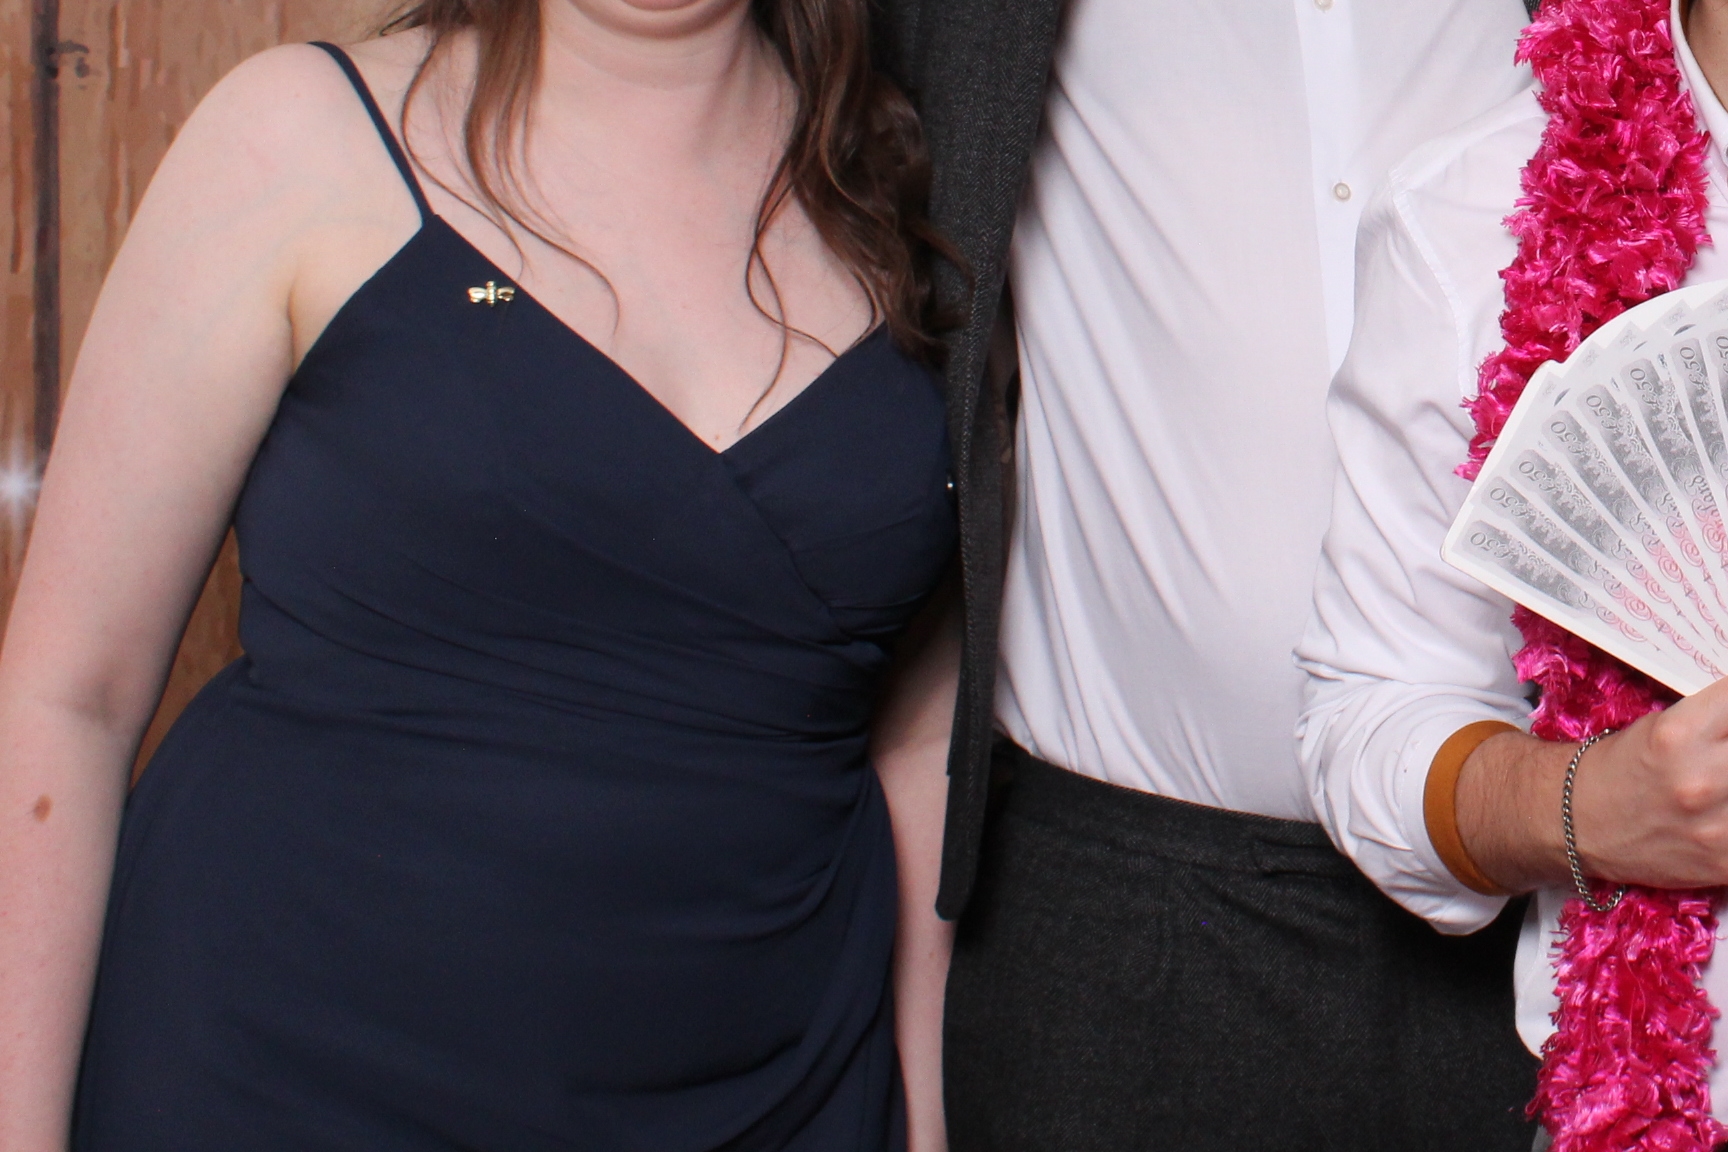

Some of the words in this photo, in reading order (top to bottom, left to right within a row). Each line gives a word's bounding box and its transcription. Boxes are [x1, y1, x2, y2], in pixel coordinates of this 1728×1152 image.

[1679, 346, 1707, 387] £50
[1630, 367, 1658, 406] £50
[1586, 394, 1617, 431] £50
[1550, 420, 1588, 455] £50
[1518, 460, 1559, 492] £50
[1489, 487, 1532, 517] £50
[1470, 531, 1516, 559] £50
